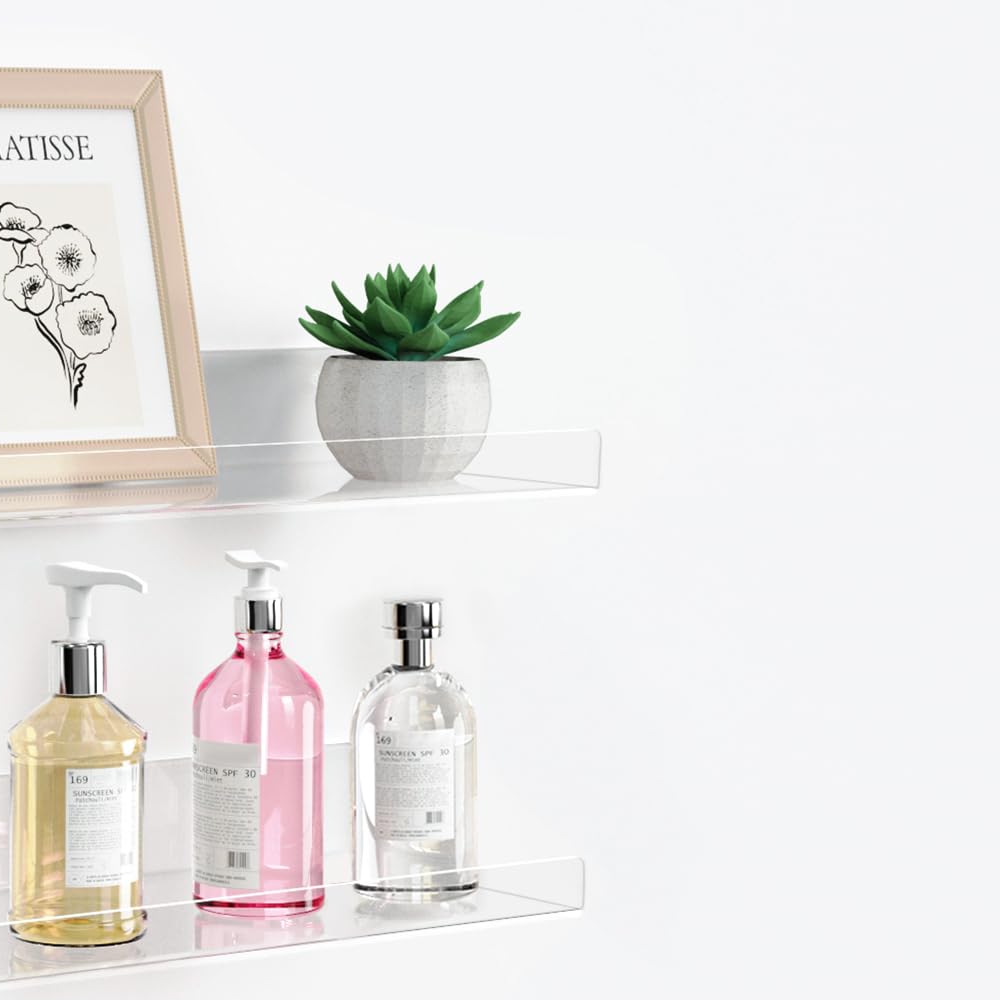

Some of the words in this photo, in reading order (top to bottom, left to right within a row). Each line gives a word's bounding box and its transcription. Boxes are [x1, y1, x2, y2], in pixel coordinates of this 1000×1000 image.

[376, 736, 392, 745] 169
[379, 749, 416, 757] SUNSCREEN
[222, 769, 238, 777] SPF
[244, 769, 256, 778] 30
[70, 775, 89, 785] 169
[72, 789, 114, 798] SUNSCREEN
